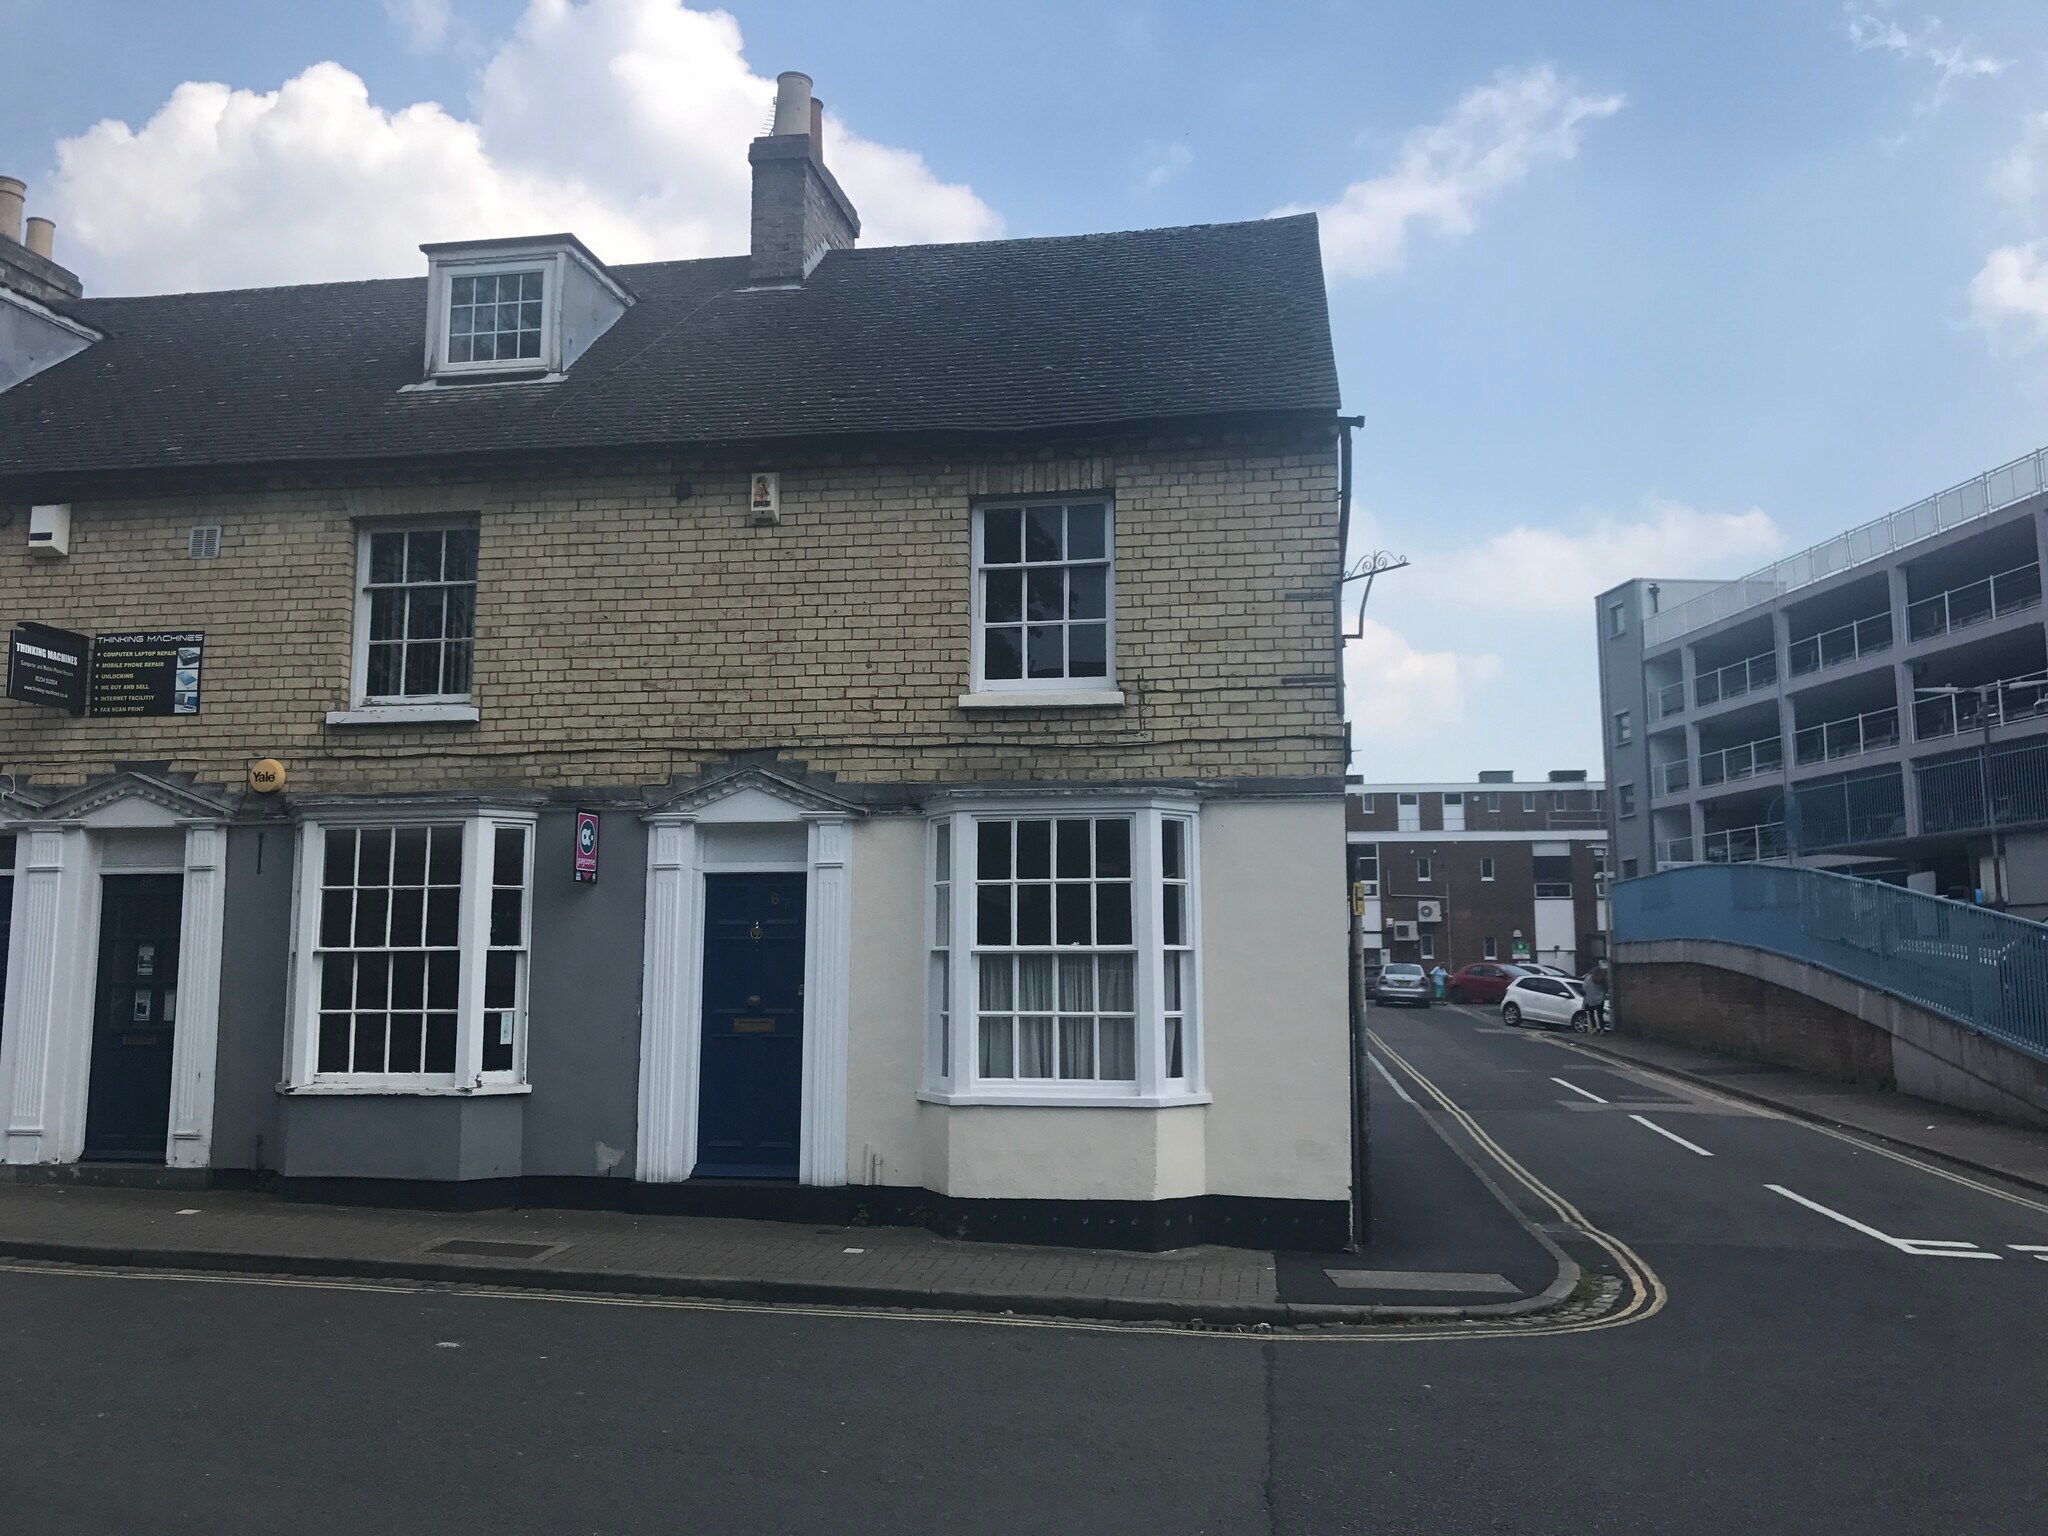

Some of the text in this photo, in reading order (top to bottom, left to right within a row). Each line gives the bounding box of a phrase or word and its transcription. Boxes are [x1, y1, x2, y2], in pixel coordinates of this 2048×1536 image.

[96, 634, 203, 644] THINKING MACHINES
[16, 642, 78, 666] THINKING MACHINES
[253, 772, 276, 782] Yale
[771, 892, 780, 905] 6
